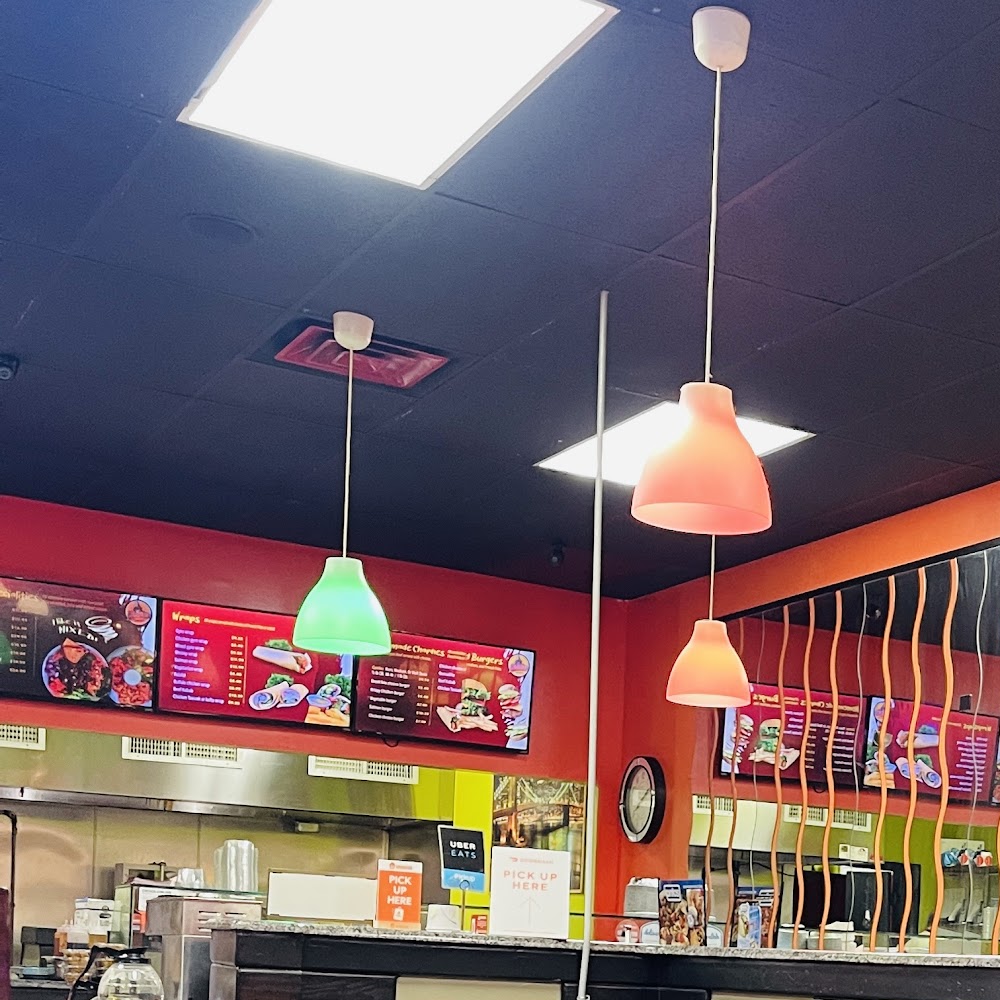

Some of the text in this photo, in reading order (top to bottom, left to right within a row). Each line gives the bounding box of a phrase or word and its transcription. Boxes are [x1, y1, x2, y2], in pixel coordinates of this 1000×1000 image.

[171, 611, 200, 624] Wraps
[471, 652, 503, 666] Burgers
[449, 840, 477, 851] UBER
[450, 849, 477, 859] EATS
[388, 874, 412, 886] PICK
[503, 870, 558, 881] PICK UP
[392, 885, 408, 895] UP
[512, 881, 549, 891] HERE
[386, 895, 412, 906] HERE
